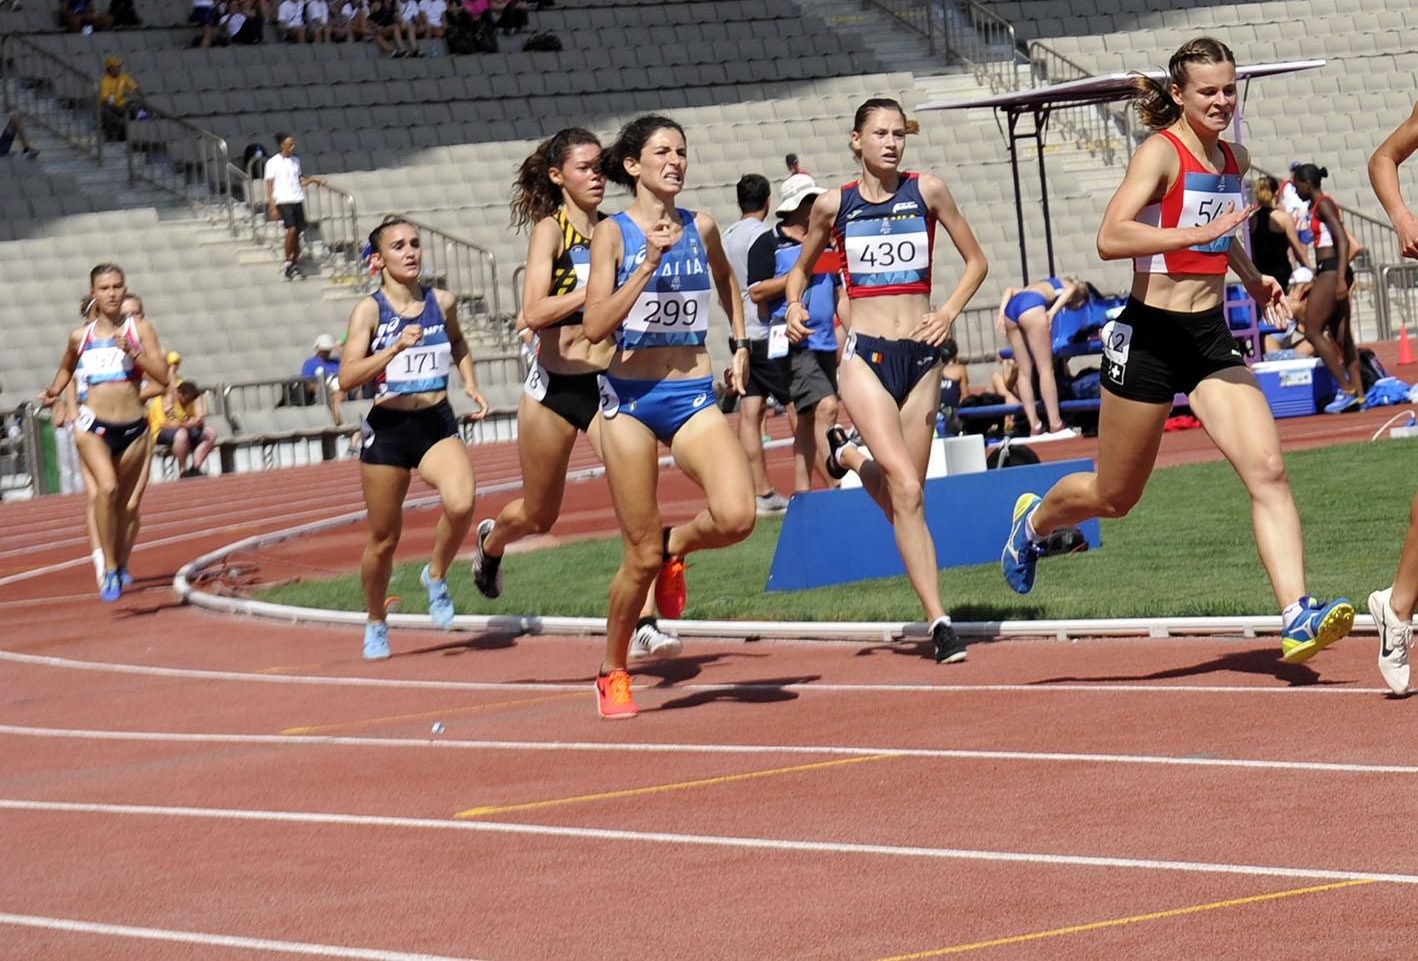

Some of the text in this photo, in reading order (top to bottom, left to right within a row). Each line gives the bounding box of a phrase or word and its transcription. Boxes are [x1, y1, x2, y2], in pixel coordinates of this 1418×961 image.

[1194, 198, 1231, 228] 54
[860, 241, 916, 267] 430
[653, 258, 704, 276] ALIA
[643, 299, 698, 327] 299
[1105, 330, 1125, 353] 12
[404, 352, 439, 374] 171
[529, 369, 541, 389] 8
